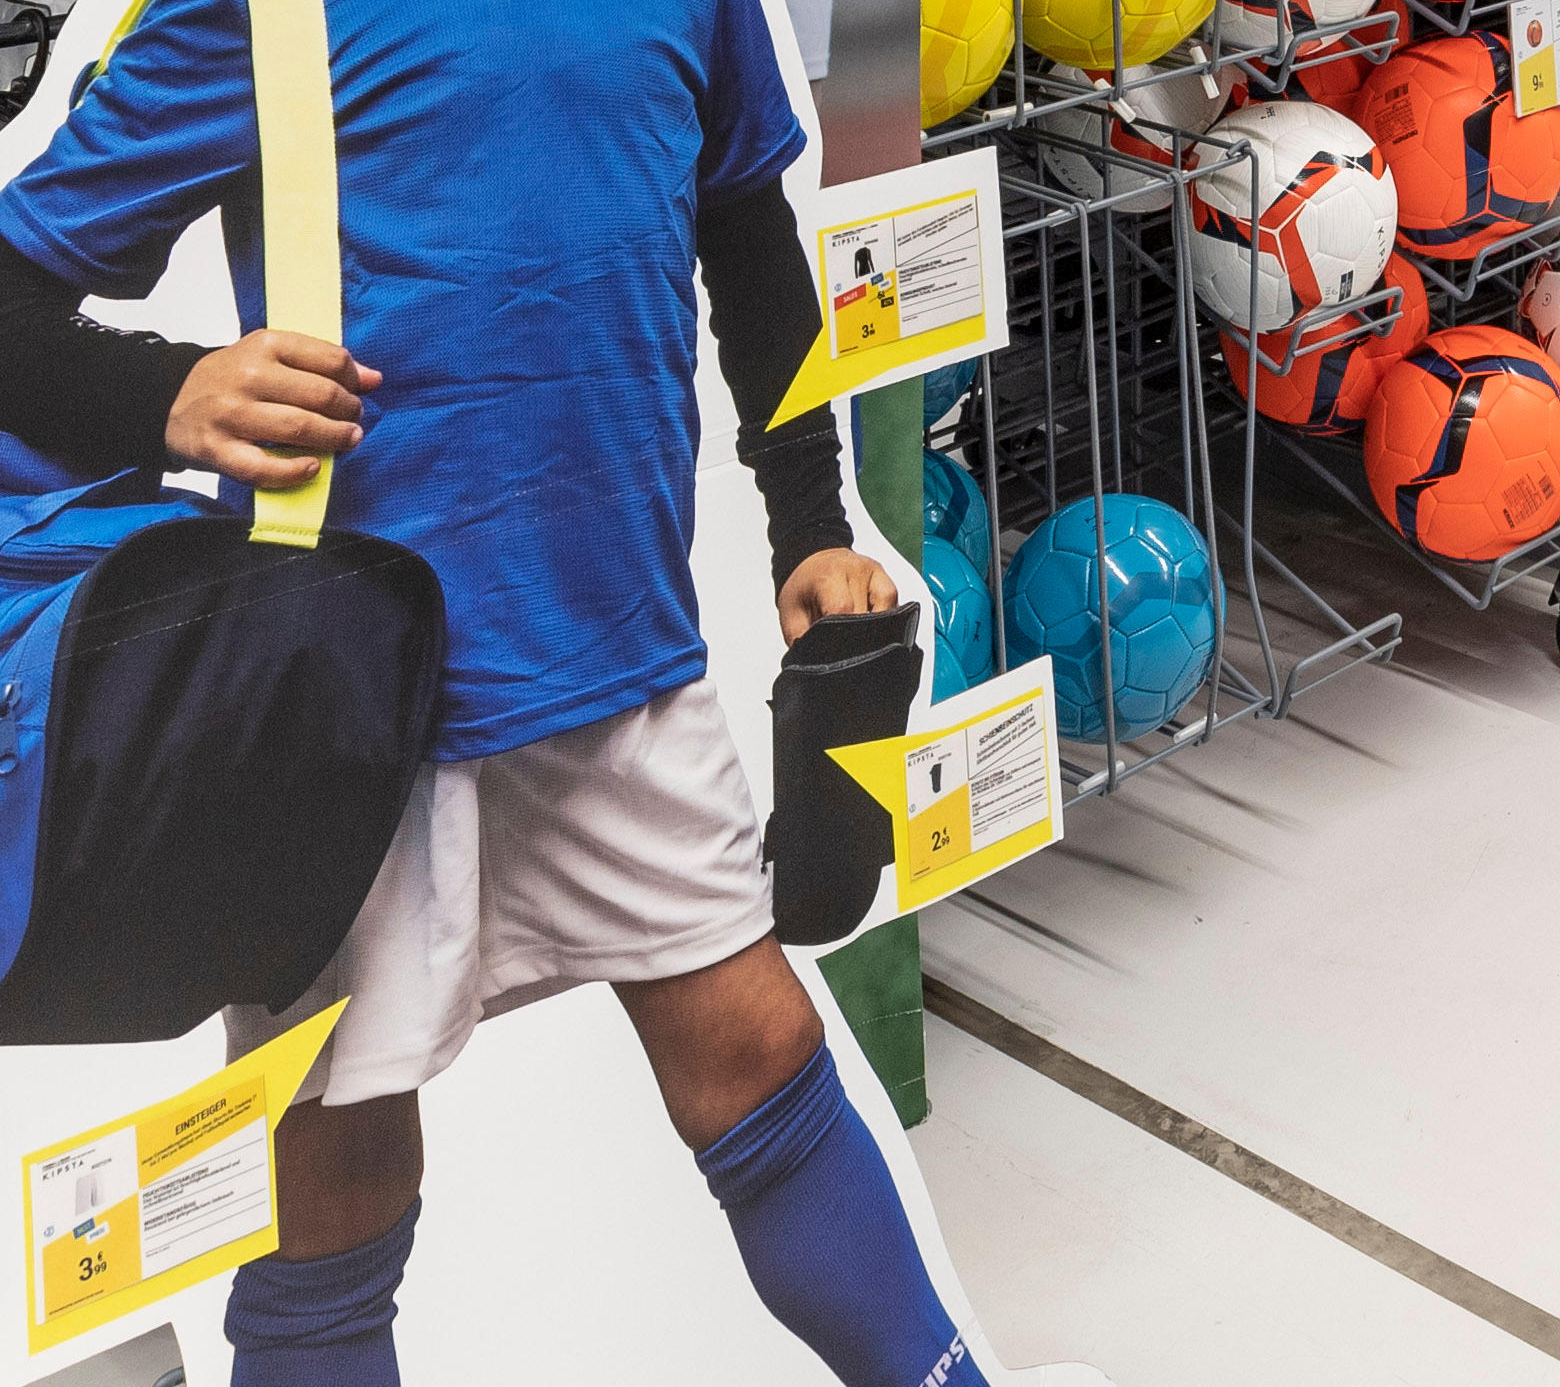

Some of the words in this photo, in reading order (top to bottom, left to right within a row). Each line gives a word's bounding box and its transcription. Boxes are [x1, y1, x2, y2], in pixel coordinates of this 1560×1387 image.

[832, 235, 860, 247] KIPSTA
[862, 324, 869, 339] 3
[907, 753, 934, 767] KIPSTA
[931, 831, 941, 852] 2
[174, 1098, 228, 1136] EINSTEIGER
[42, 1159, 85, 1181] KIPSTA
[79, 1256, 93, 1282] 3
[93, 1261, 107, 1275] 99
